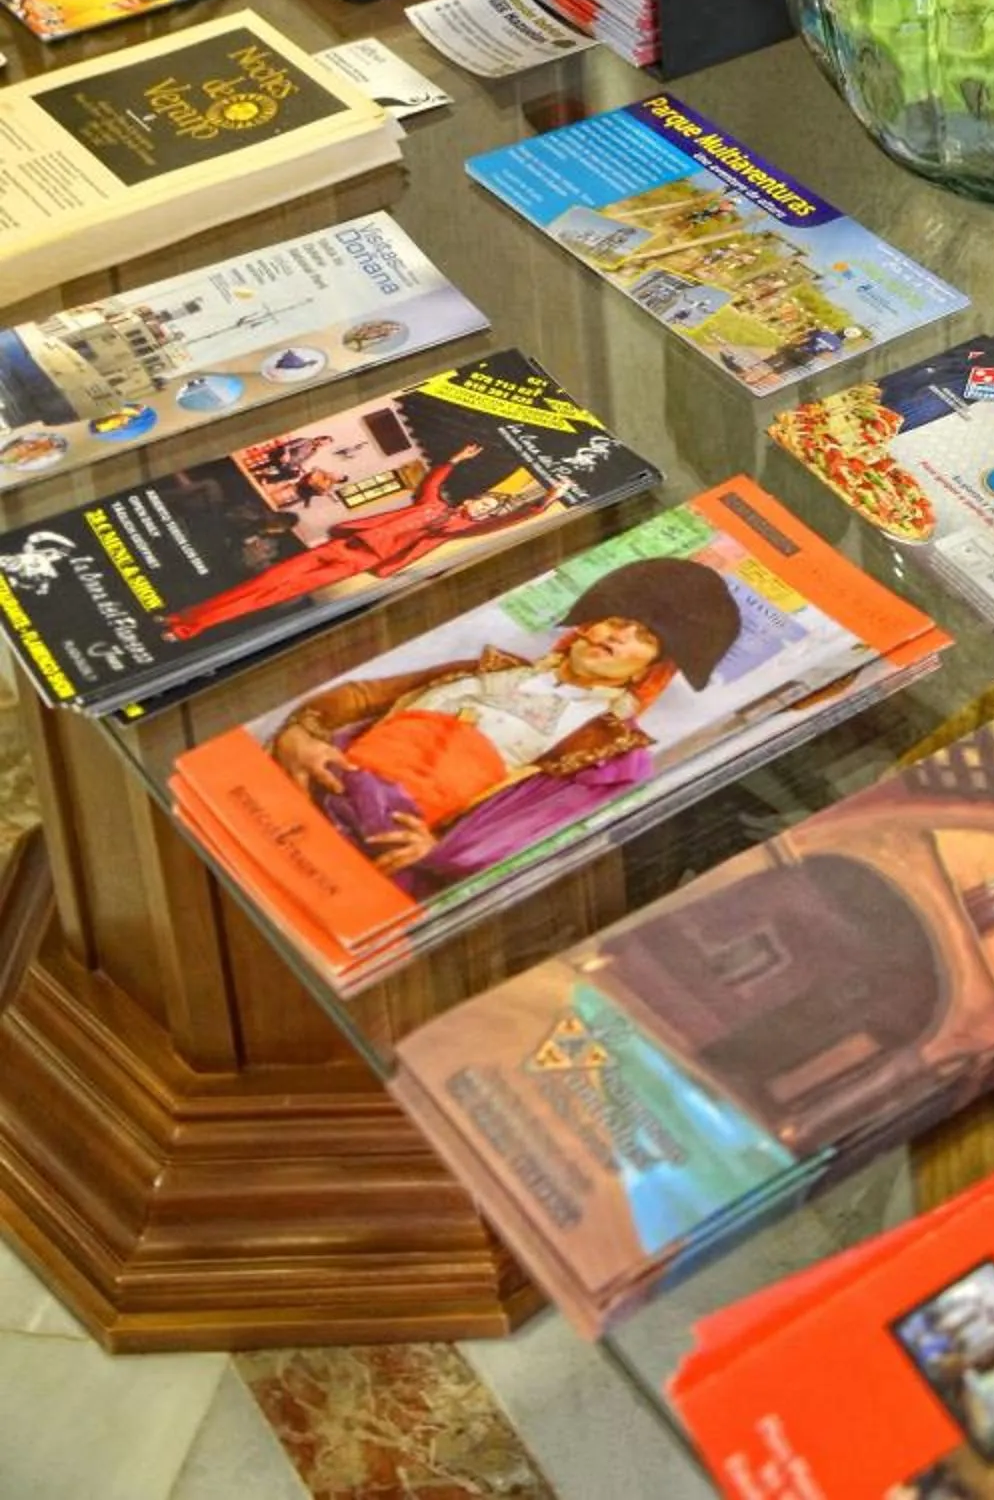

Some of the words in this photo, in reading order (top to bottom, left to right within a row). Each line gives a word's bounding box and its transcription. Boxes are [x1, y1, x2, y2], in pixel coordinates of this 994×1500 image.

[227, 44, 301, 99] Noches
[143, 76, 220, 141] Verano
[642, 96, 703, 141] Parque
[698, 132, 817, 218] Multiaventuras
[335, 229, 400, 295] Doñana
